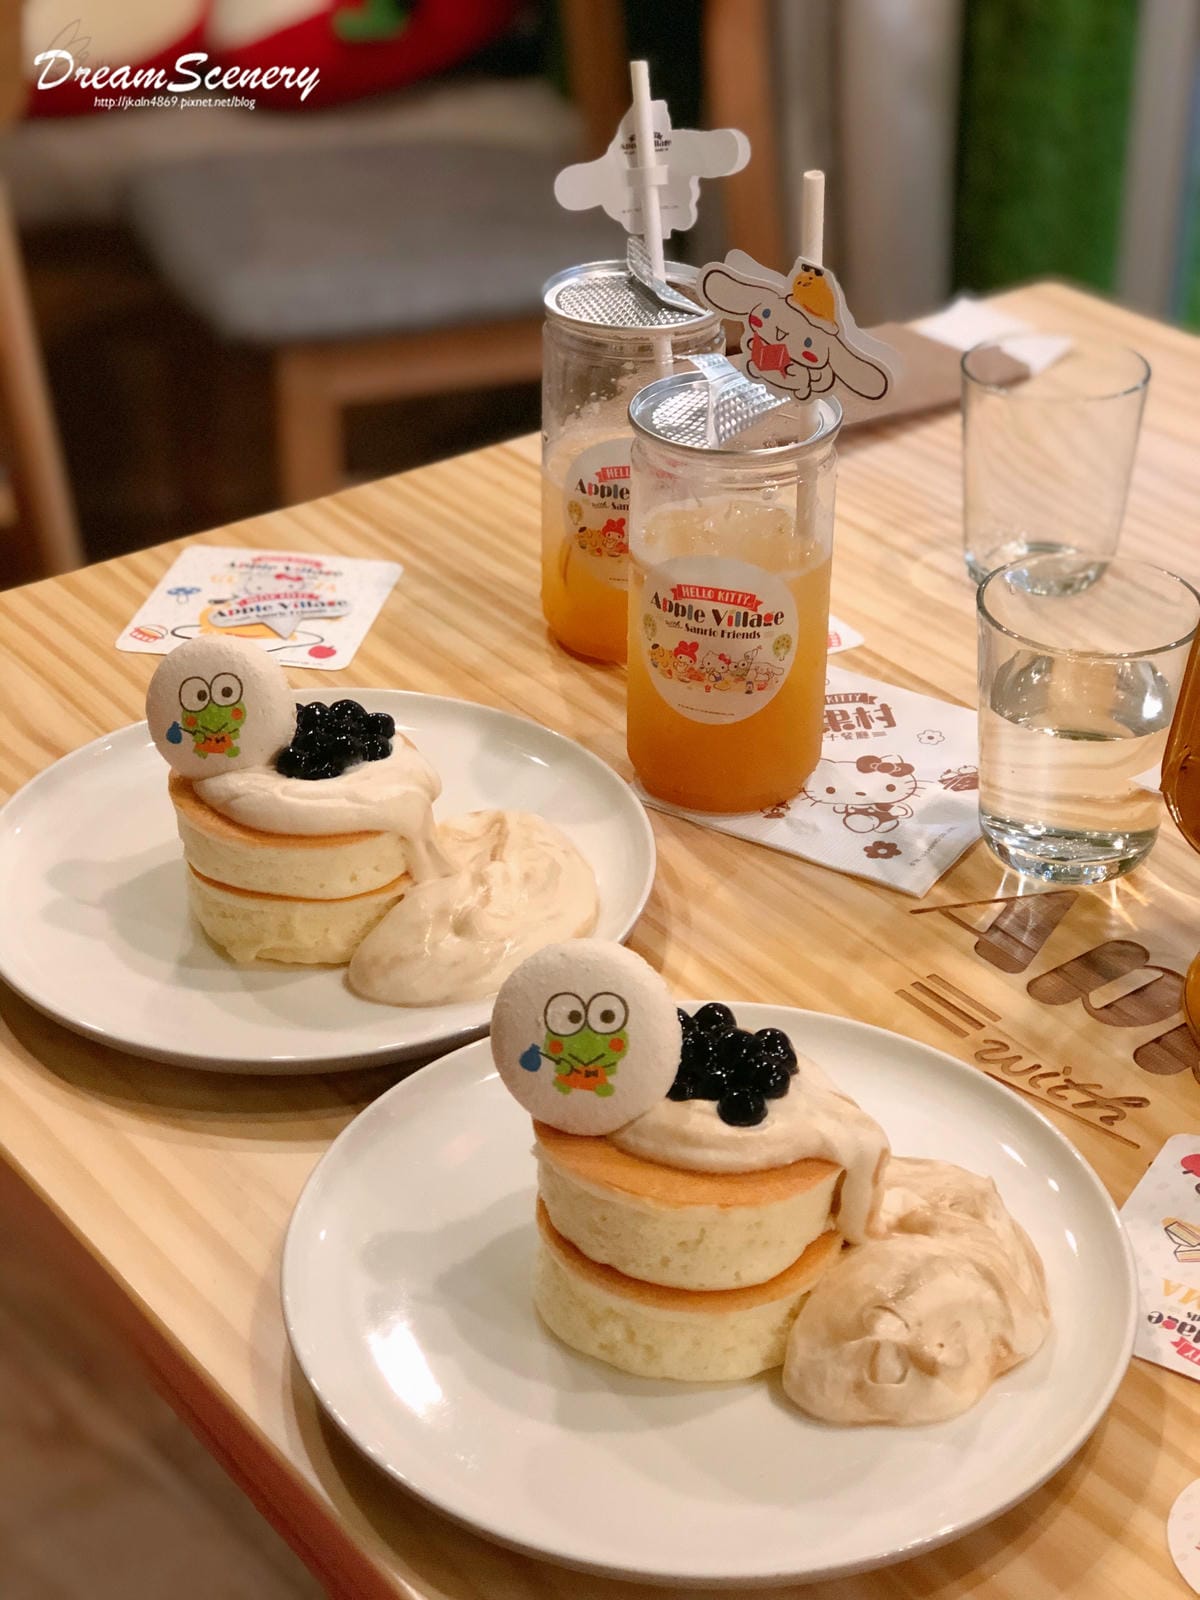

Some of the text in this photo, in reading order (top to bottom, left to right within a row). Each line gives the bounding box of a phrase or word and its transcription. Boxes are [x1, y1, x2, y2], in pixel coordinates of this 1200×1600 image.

[575, 479, 630, 500] Apple
[682, 586, 752, 606] HELLO KITTY
[651, 592, 785, 628] Apple Village
[684, 623, 719, 638] Sanrio
[720, 630, 761, 640] Friends
[826, 694, 861, 704] KITTY
